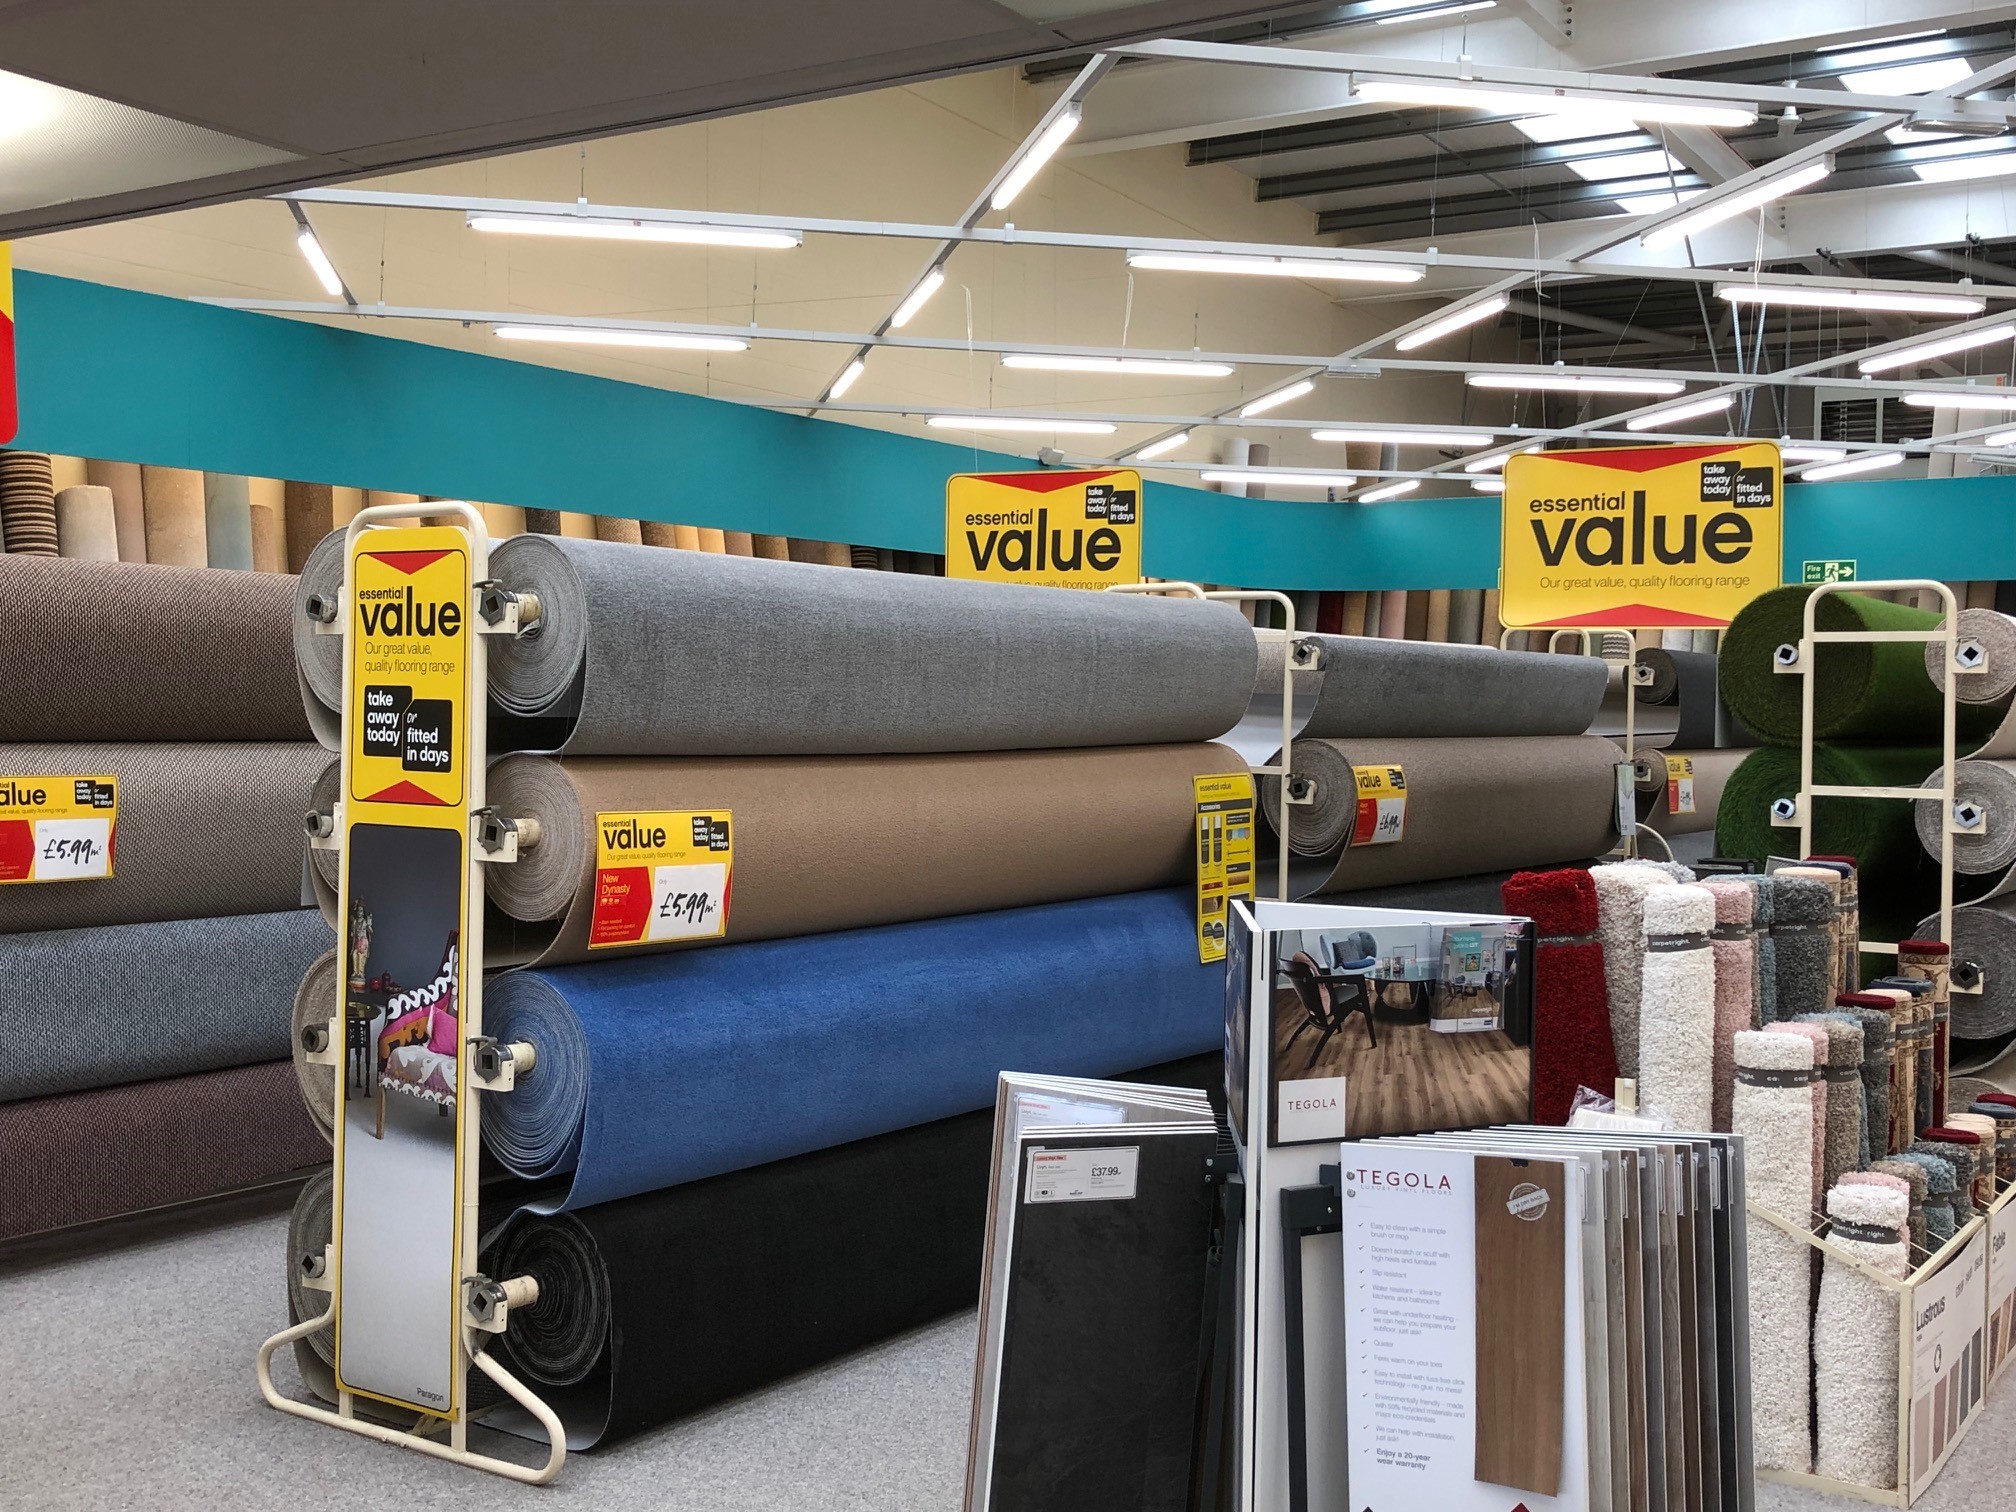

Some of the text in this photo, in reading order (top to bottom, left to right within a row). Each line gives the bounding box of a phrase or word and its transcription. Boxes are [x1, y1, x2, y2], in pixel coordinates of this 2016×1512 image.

[1704, 465, 1725, 474] take
[1704, 476, 1730, 486] away
[1737, 484, 1762, 492] fitted
[1088, 488, 1103, 496] take
[1704, 485, 1731, 496] today
[1530, 492, 1625, 512] essential
[1737, 493, 1771, 504] in days
[1088, 505, 1107, 514] today
[1111, 504, 1128, 512] fitted
[966, 509, 1033, 525] essential
[1118, 513, 1134, 522] days
[1530, 490, 1753, 566] value
[966, 509, 1121, 571] value
[1540, 575, 1750, 591] Our great value, quality flooring range
[359, 586, 403, 600] essential
[360, 586, 461, 637] value
[365, 642, 381, 655] Our
[384, 643, 405, 657] great
[365, 658, 455, 675] quality flooring range
[368, 691, 393, 706] take
[368, 711, 399, 728] away
[368, 727, 400, 746] today
[407, 728, 438, 744] fitted
[407, 746, 449, 766] in days
[1357, 770, 1381, 788] value
[0, 782, 46, 805] alue
[604, 819, 666, 849] value
[602, 874, 620, 883] New
[602, 884, 630, 896] Dynasty
[1288, 1098, 1336, 1110] TEGOLA
[1356, 1169, 1451, 1190] TEGOLA
[1917, 1296, 1945, 1331] Lustrous
[417, 1388, 444, 1401] Paragon
[1377, 1448, 1395, 1458] Enjoy
[1404, 1452, 1430, 1461] 20-year
[1395, 1460, 1426, 1470] warranty
